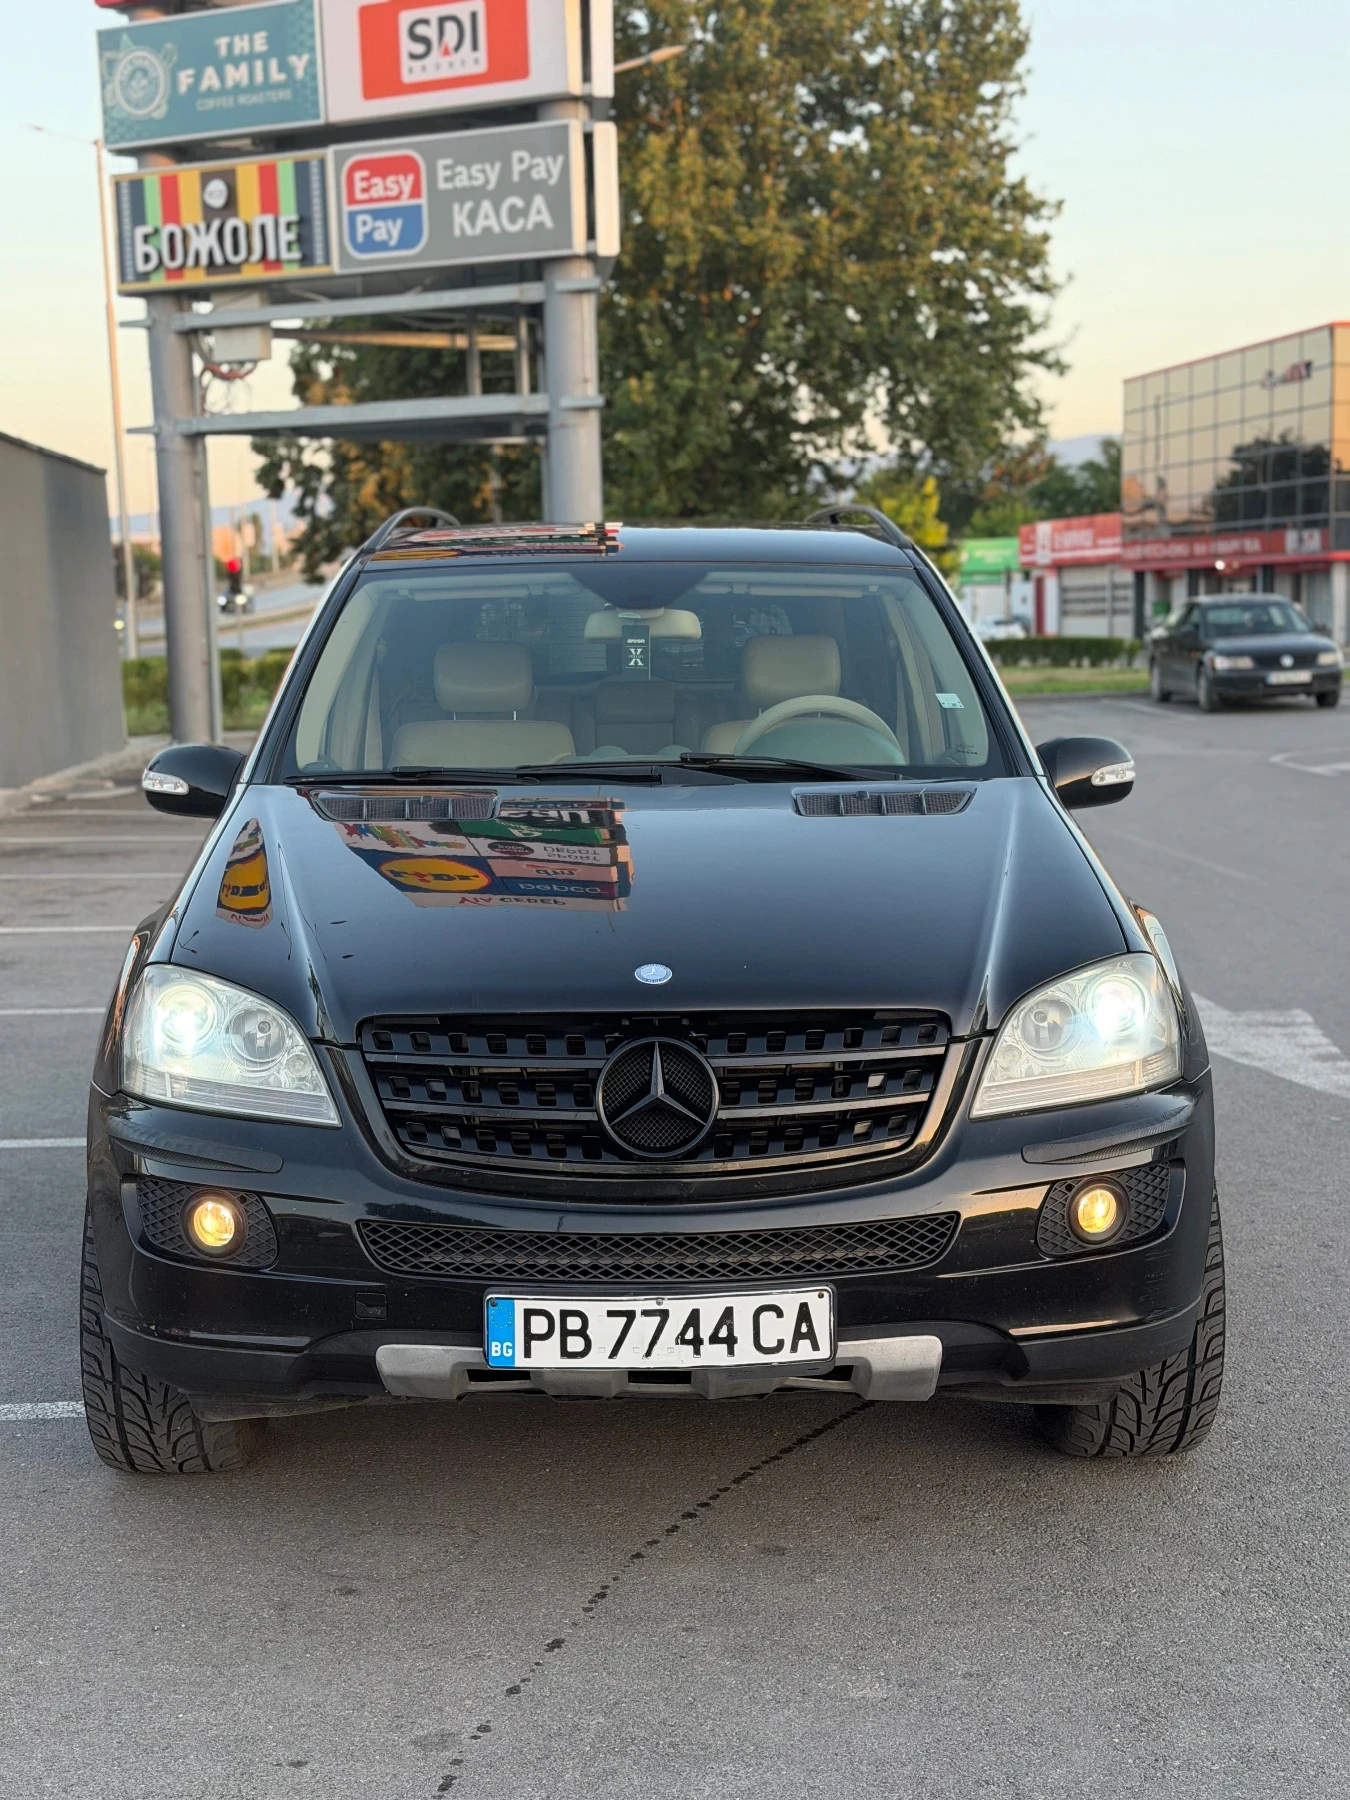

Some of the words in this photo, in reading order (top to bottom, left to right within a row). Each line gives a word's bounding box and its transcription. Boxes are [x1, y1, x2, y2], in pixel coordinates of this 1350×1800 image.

[215, 31, 268, 58] THE
[408, 10, 479, 61] SDI
[177, 53, 310, 95] FAMILY
[353, 170, 414, 200] Easy
[436, 158, 502, 191] Easy
[511, 150, 565, 186] Pay
[355, 213, 403, 246] Pay
[452, 194, 554, 238] КАСА
[134, 213, 302, 274] БОЖОЛЕ
[491, 1341, 513, 1357] BG
[523, 1308, 592, 1360] PB
[606, 1306, 738, 1360] 7744
[752, 1302, 820, 1355] CA
